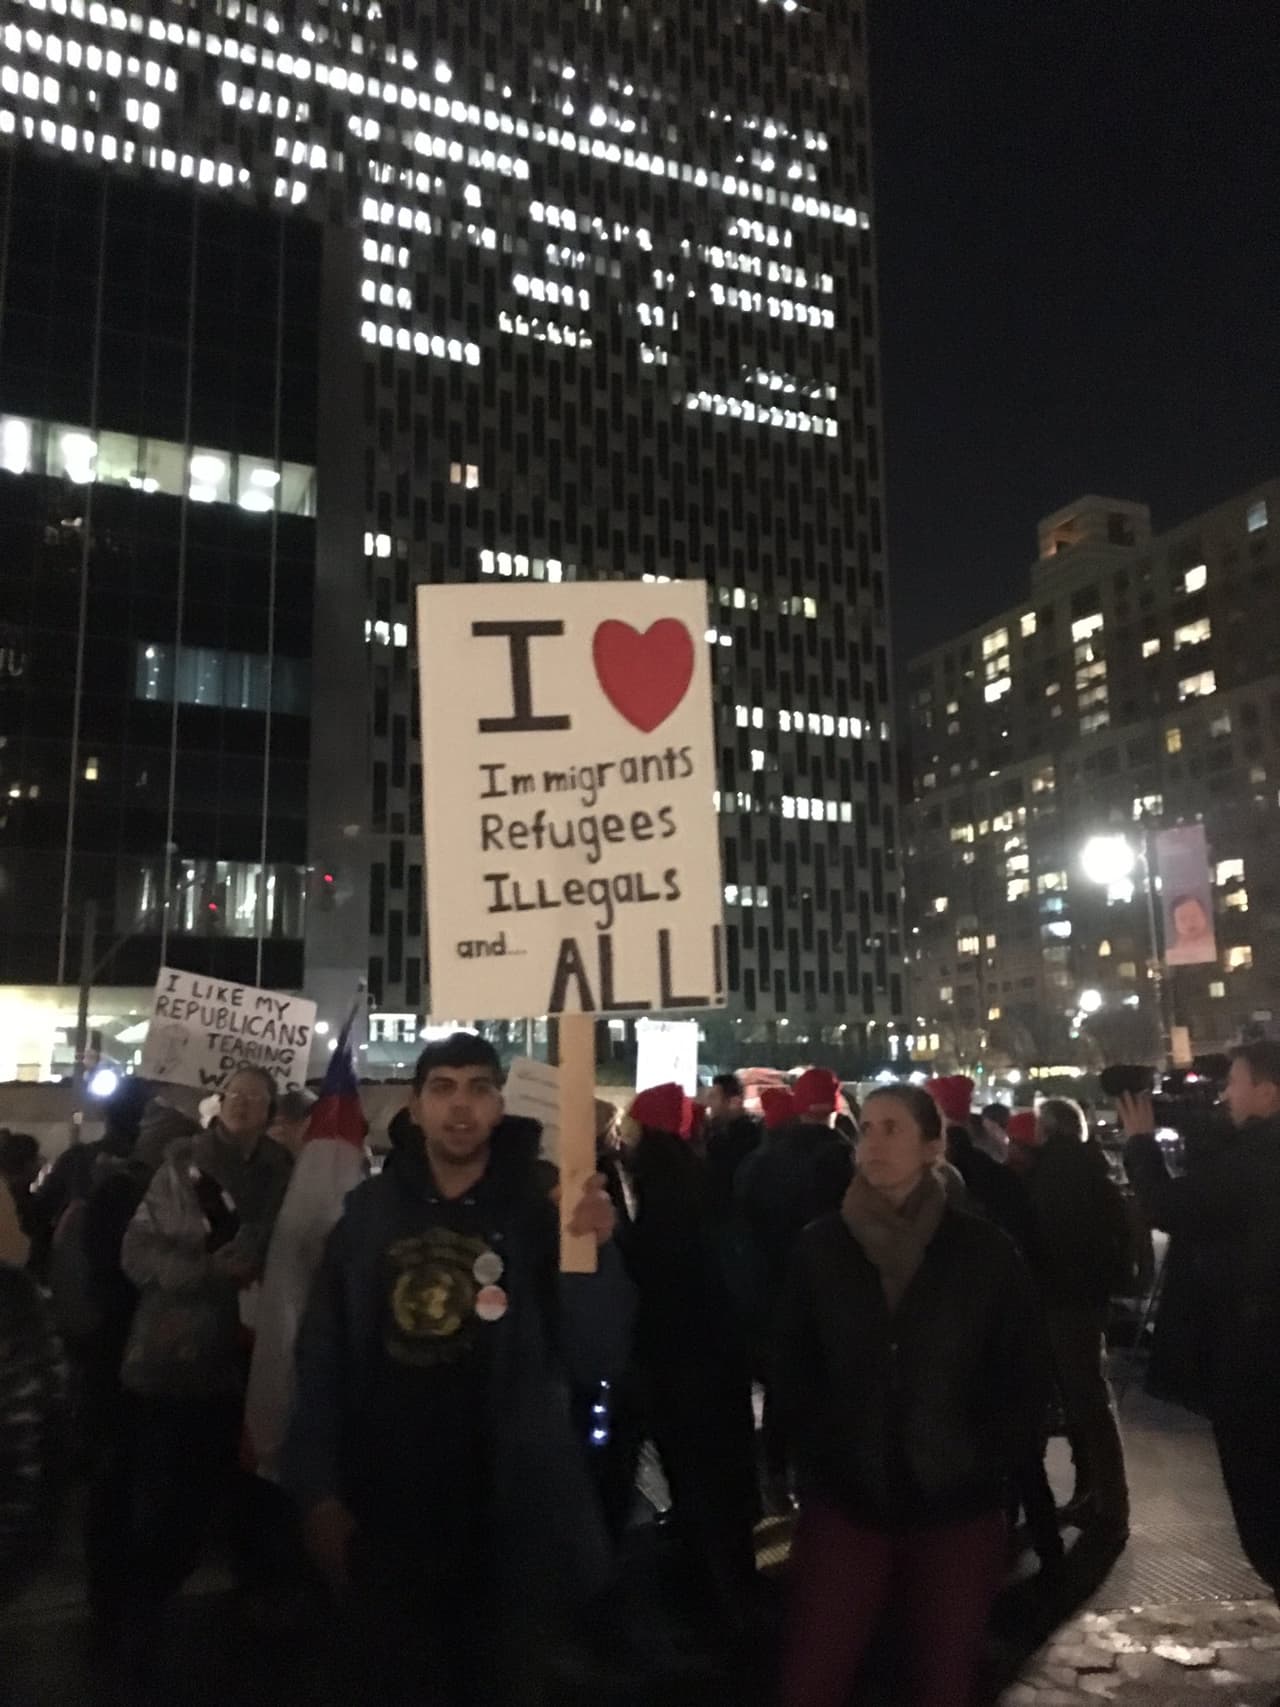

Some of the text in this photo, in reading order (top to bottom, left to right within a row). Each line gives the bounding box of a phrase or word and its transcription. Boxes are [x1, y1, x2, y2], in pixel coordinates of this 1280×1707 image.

[471, 619, 571, 733] I
[478, 745, 694, 807] Immigrants
[481, 805, 677, 864] Refugees
[166, 974, 290, 1021] I LIKE MY
[547, 924, 724, 1014] ALL!
[155, 995, 309, 1047] REPUBLICANS
[207, 1033, 295, 1064] TEARING
